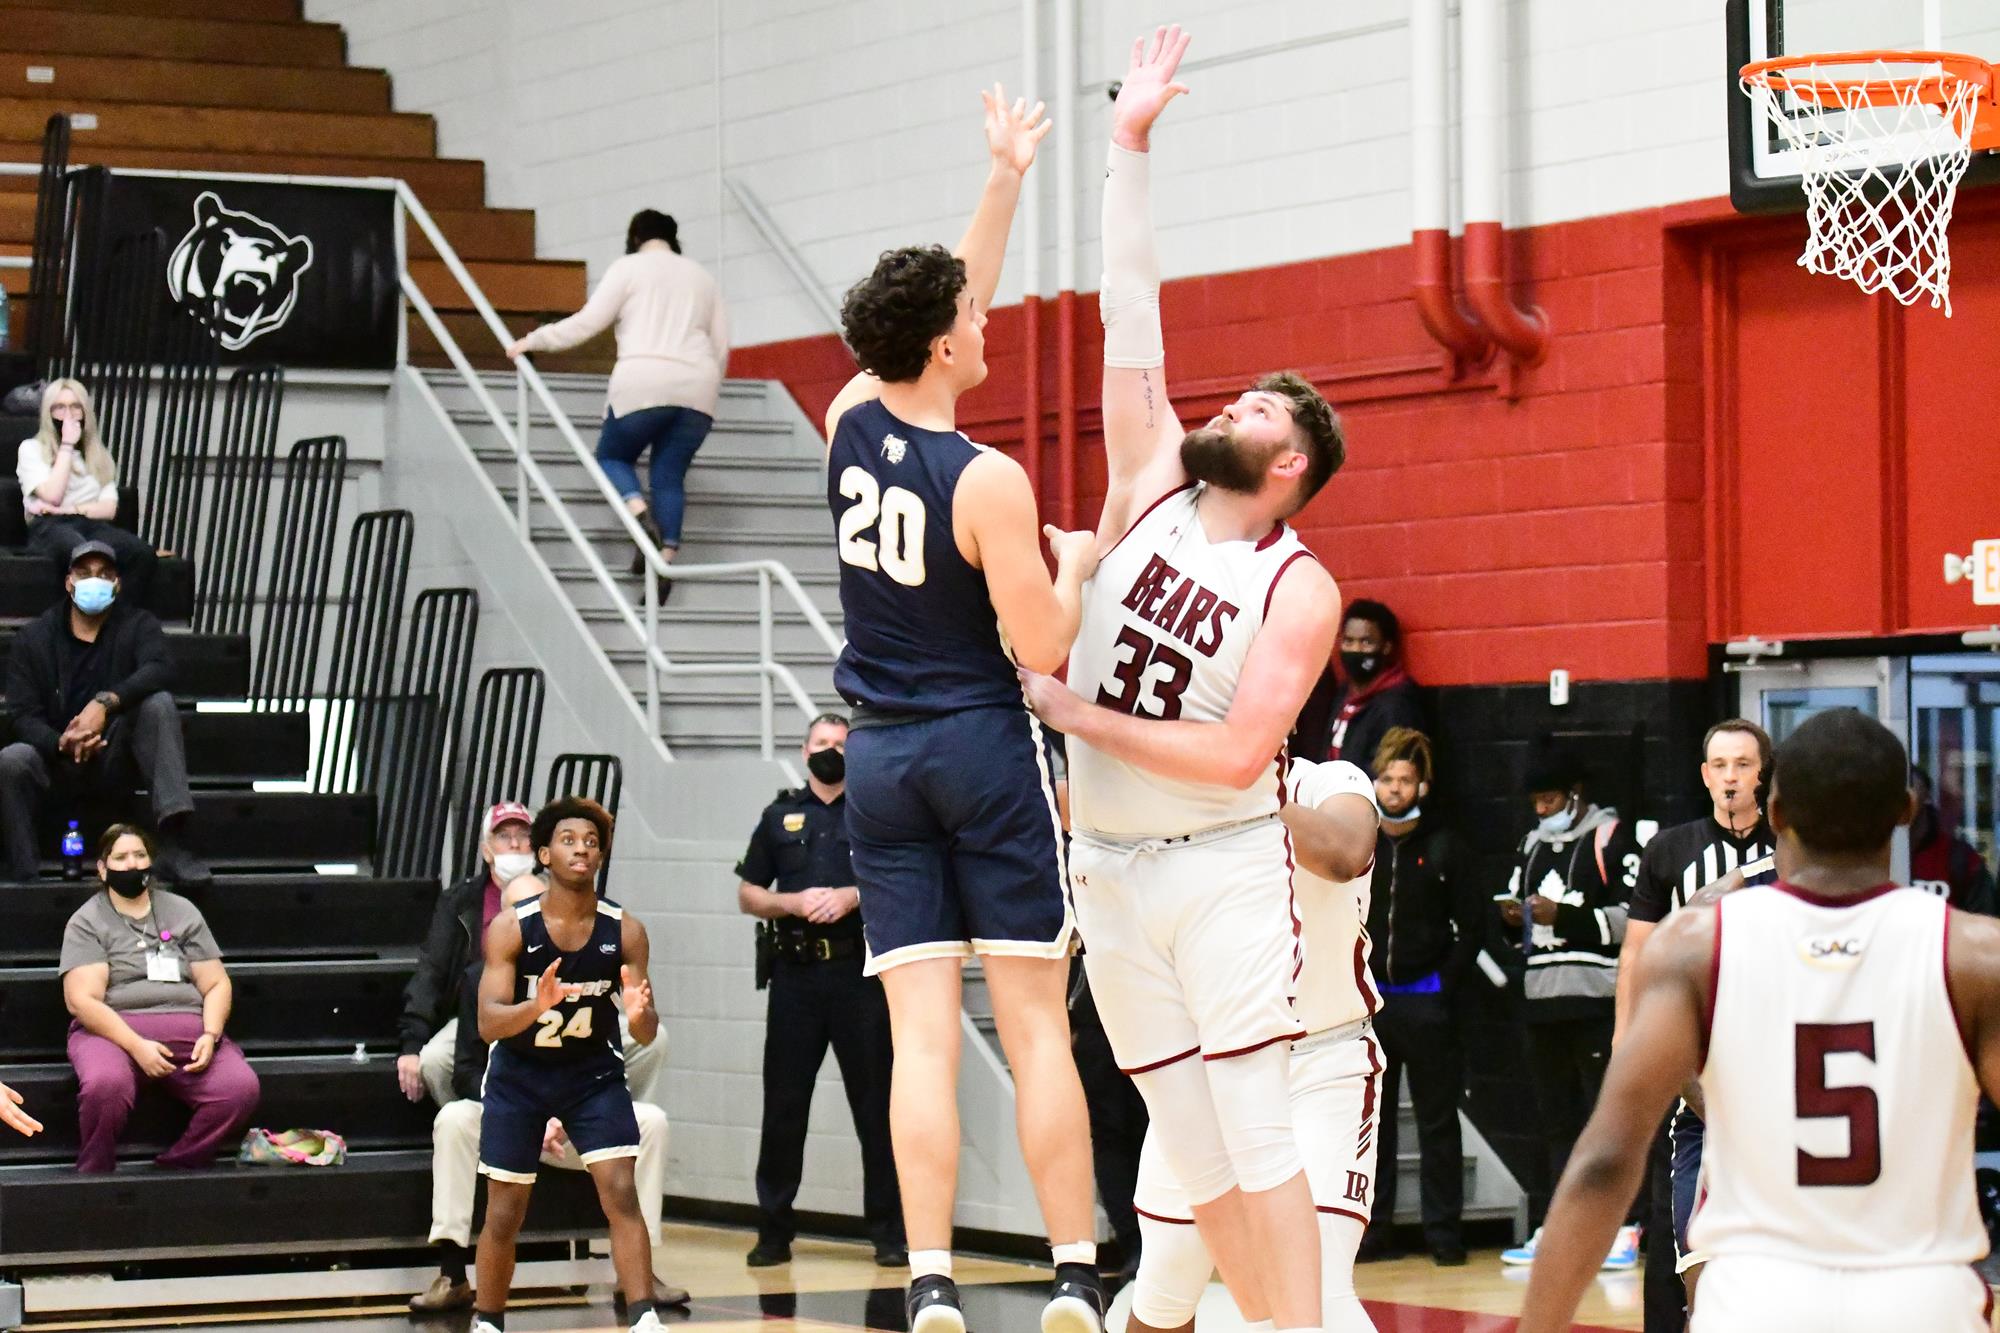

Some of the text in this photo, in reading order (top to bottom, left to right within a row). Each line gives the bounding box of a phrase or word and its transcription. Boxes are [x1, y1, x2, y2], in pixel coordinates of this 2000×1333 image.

[839, 466, 926, 587] 20
[1986, 546, 2000, 592] E
[1121, 552, 1240, 658] BEARS
[1096, 624, 1193, 720] 33
[1810, 939, 1860, 957] SAC
[534, 1006, 593, 1048] 24
[1795, 1021, 1881, 1187] 5
